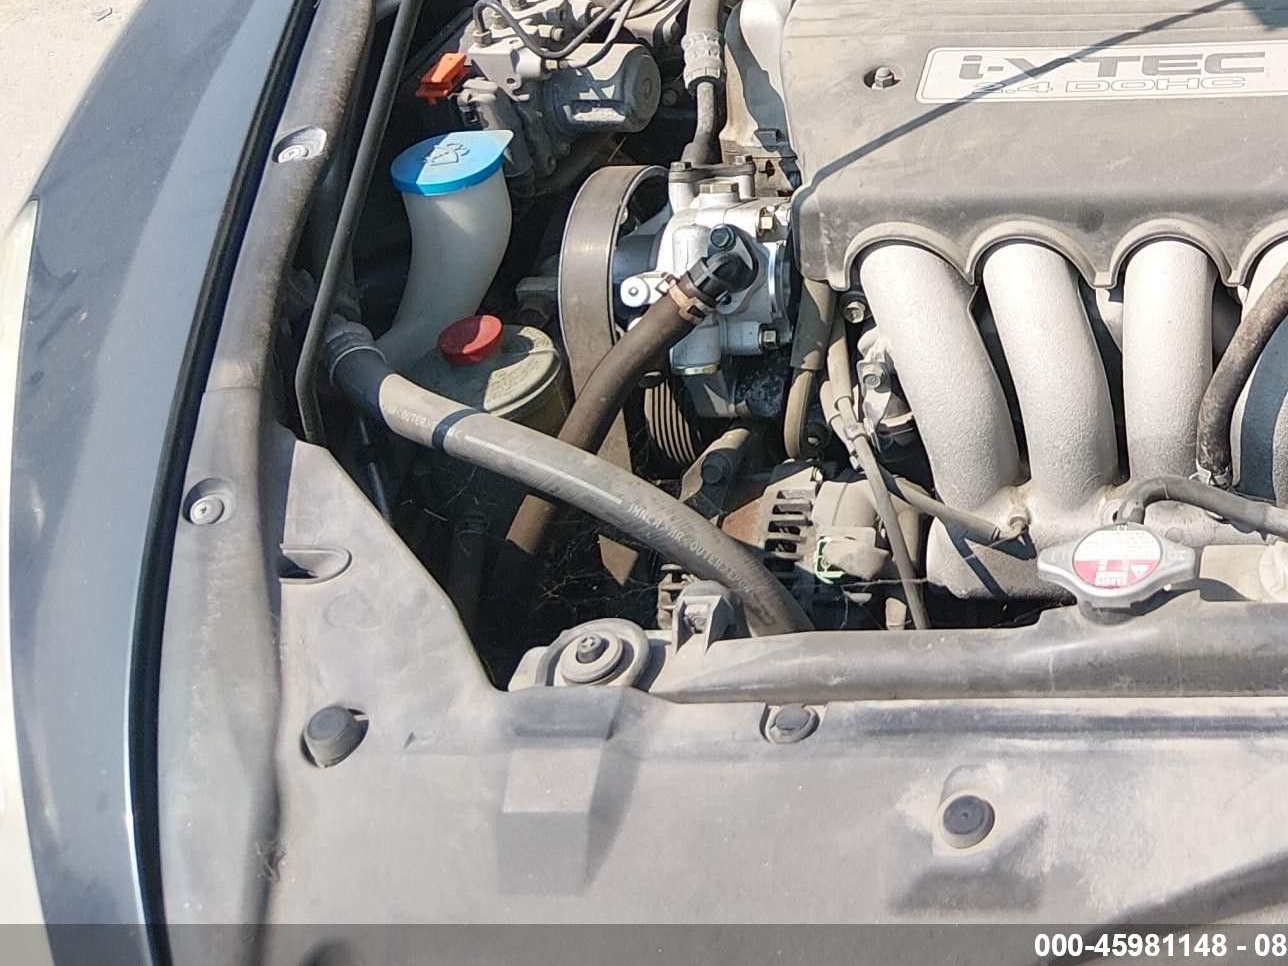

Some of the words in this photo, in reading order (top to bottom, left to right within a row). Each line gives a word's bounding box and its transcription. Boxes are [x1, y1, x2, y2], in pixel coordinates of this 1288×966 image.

[959, 52, 1266, 80] i-VTEC
[973, 81, 1054, 94] 2.4
[1064, 77, 1247, 93] DOHC
